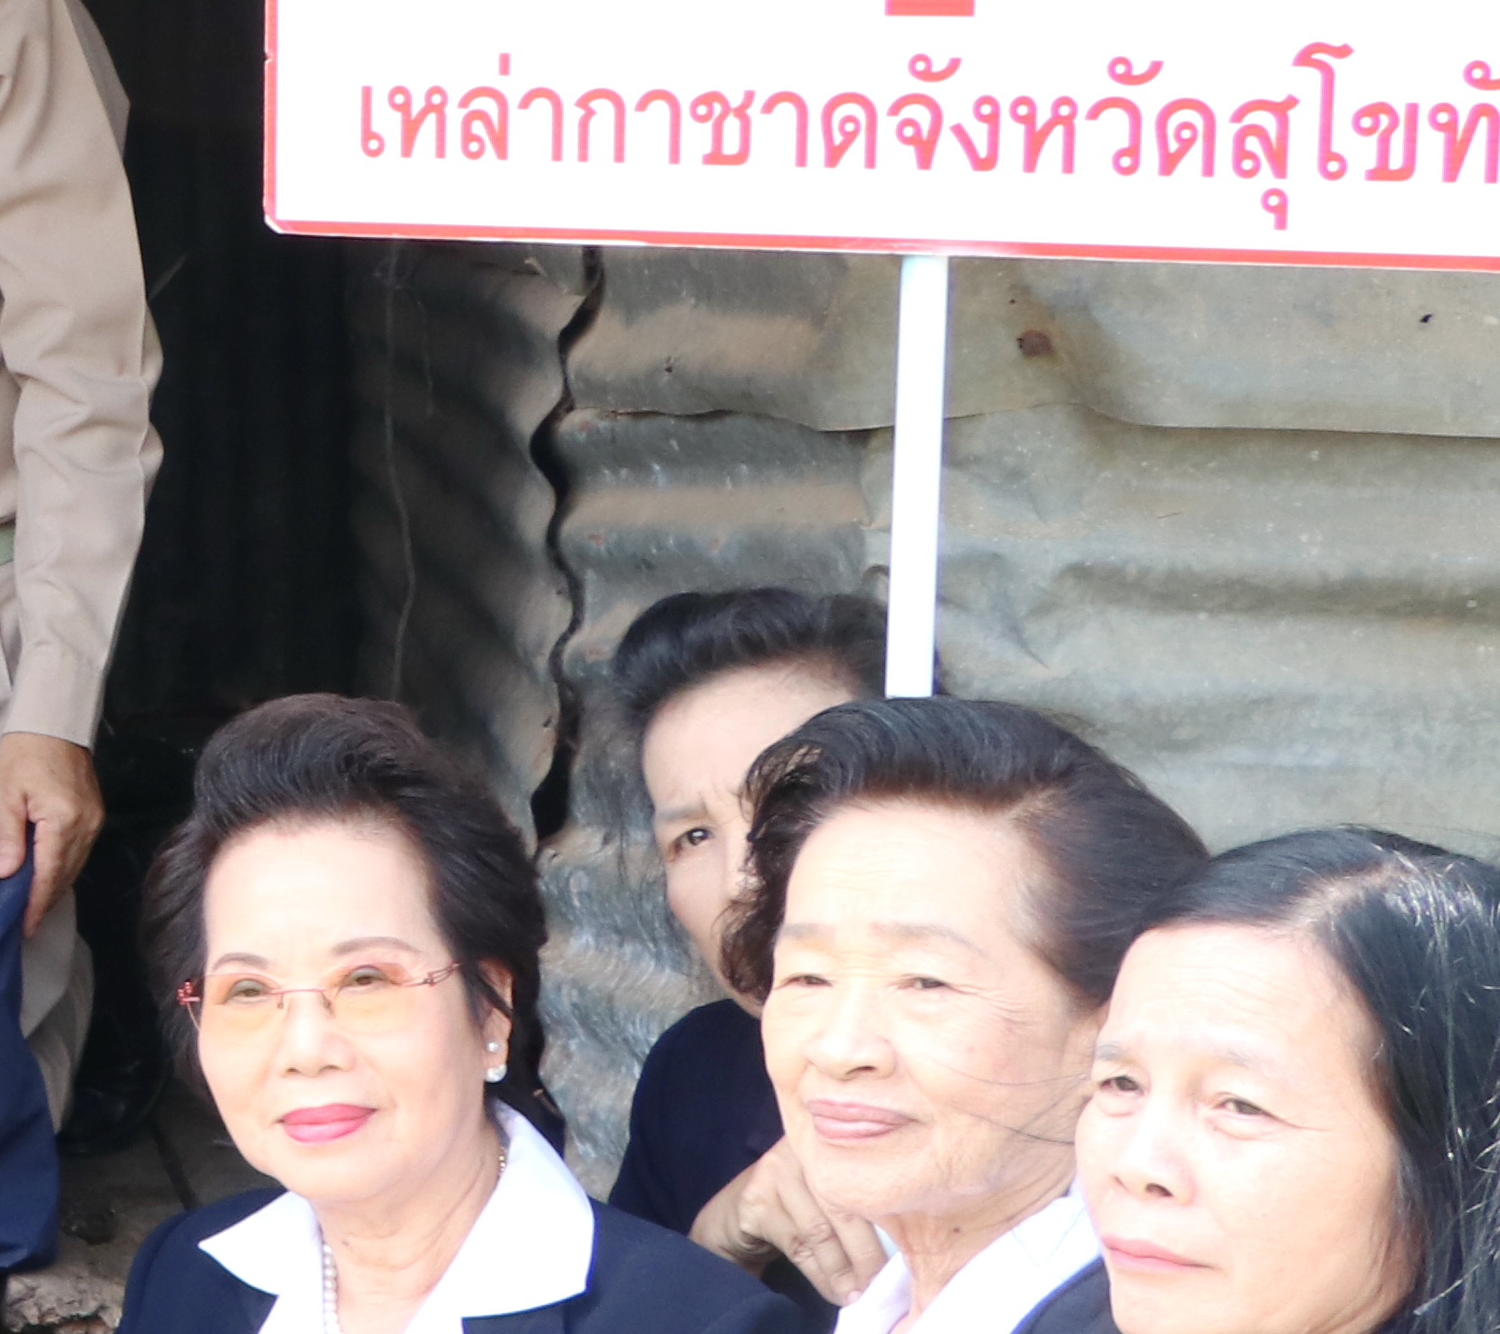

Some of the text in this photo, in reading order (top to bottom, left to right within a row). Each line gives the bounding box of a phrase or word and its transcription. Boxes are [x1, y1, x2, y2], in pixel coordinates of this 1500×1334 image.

[359, 41, 1500, 230] เหล่ากาชาดจังหวัดสุโขทั
